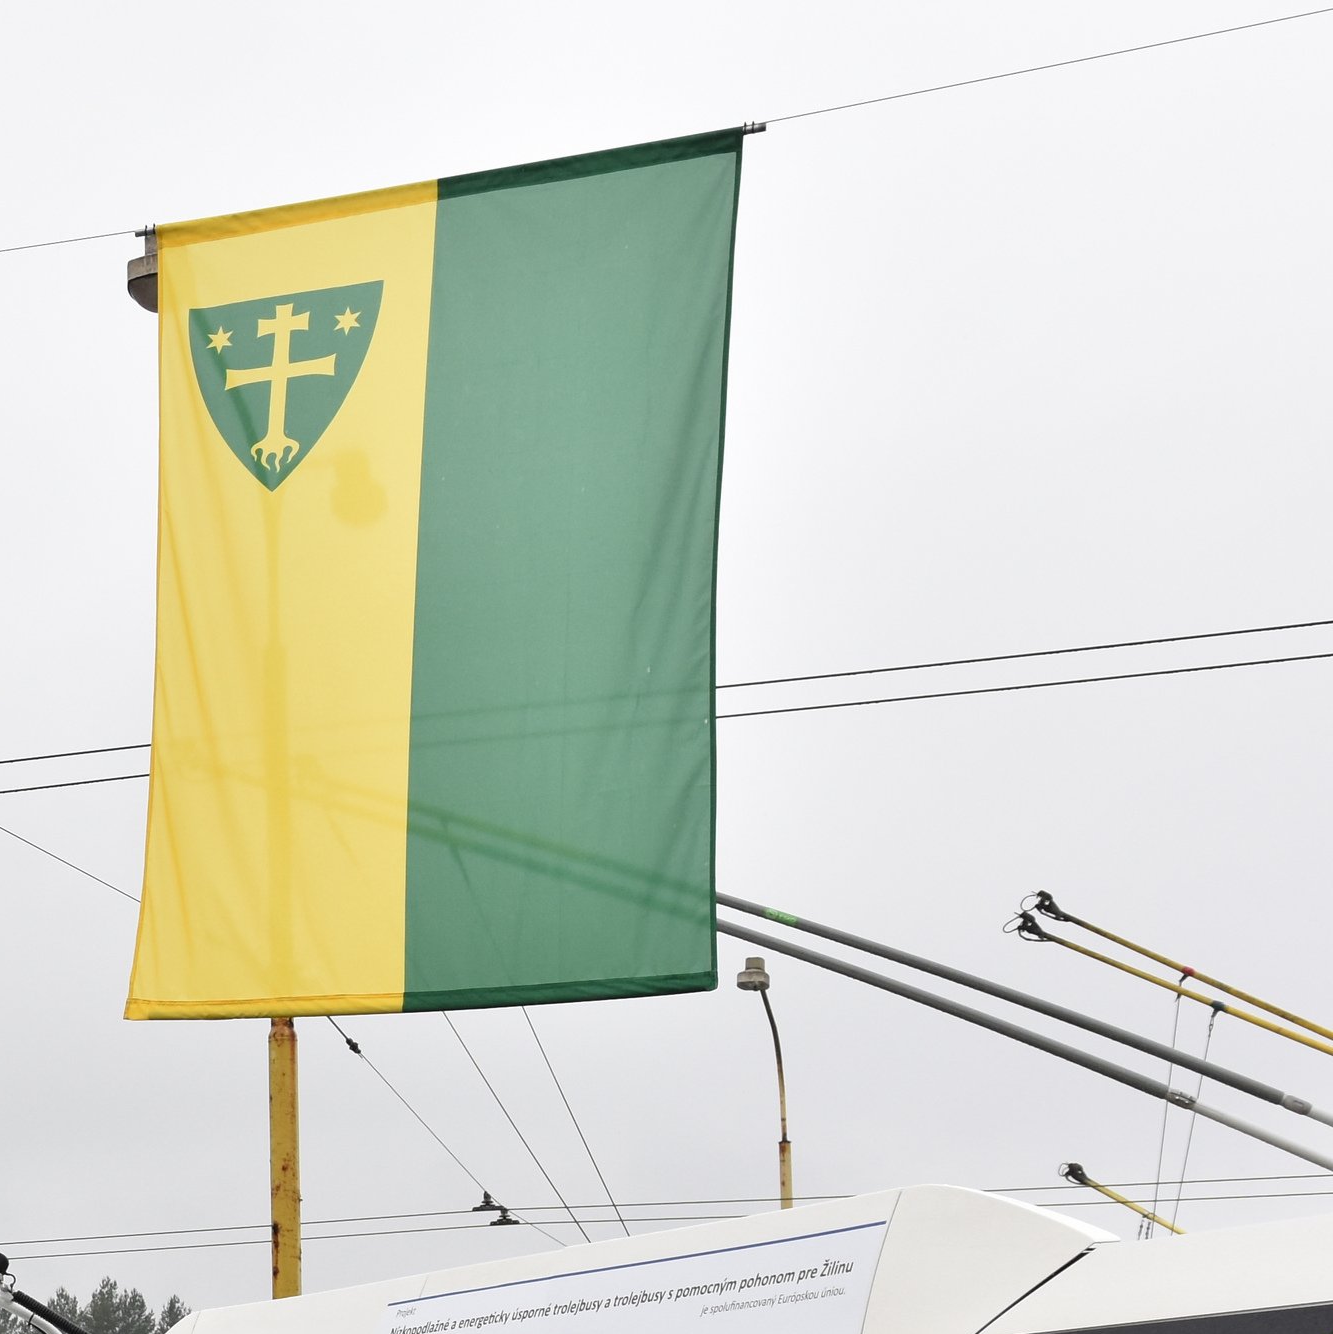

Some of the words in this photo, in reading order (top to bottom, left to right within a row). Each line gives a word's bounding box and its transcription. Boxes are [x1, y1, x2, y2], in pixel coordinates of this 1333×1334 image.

[450, 1321, 457, 1330] a
[458, 1310, 510, 1329] energeticky
[511, 1302, 551, 1323] úsporné
[553, 1297, 603, 1317] trolejbusy
[604, 1299, 611, 1308] a
[613, 1286, 665, 1307] trolejbusy
[667, 1290, 673, 1299] s
[674, 1277, 737, 1301] pomocným
[738, 1272, 795, 1292] pohonom
[796, 1266, 818, 1283] pre
[820, 1259, 854, 1277] Žilinu
[777, 1289, 820, 1307] Európskou
